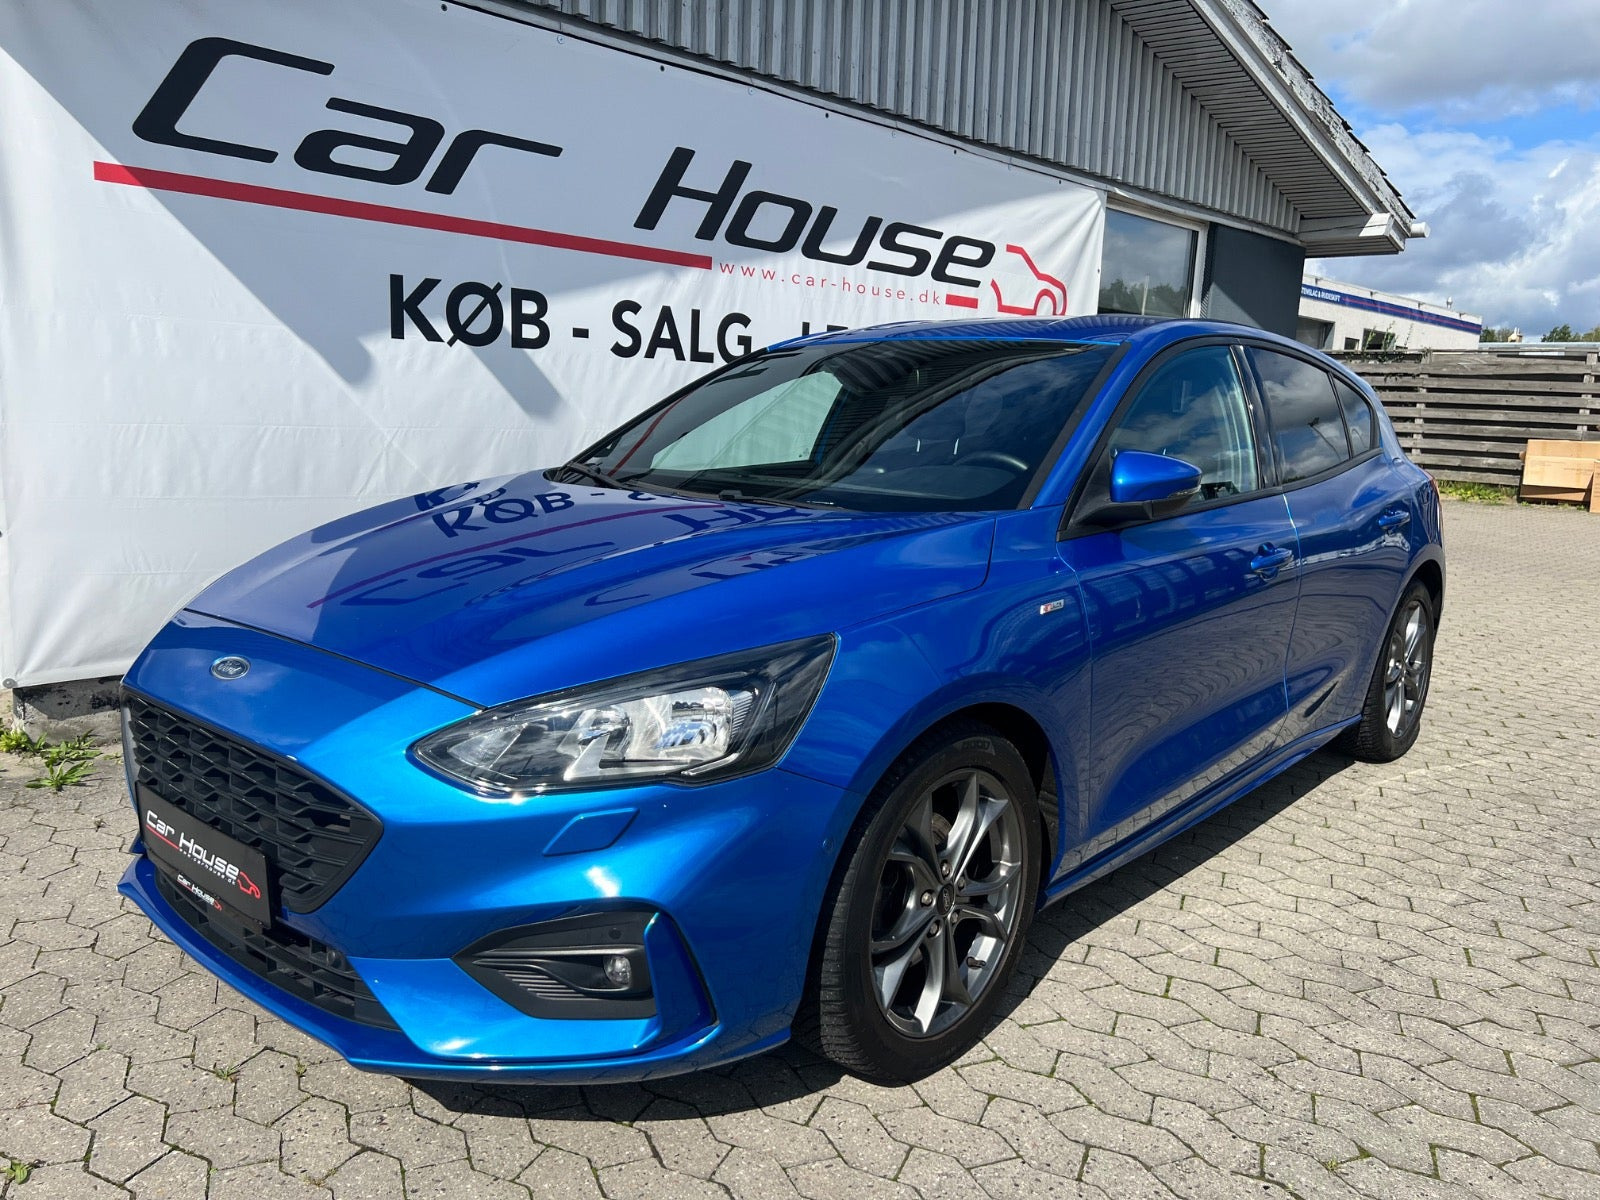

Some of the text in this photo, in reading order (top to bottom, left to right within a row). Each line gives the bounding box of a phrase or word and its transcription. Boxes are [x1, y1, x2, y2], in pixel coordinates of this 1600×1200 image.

[132, 37, 996, 289] Car House
[389, 273, 551, 350] KØB
[609, 299, 752, 364] SALG
[719, 262, 941, 305] www.car-house.dk
[146, 810, 240, 881] Car House
[177, 874, 215, 906] Car House
